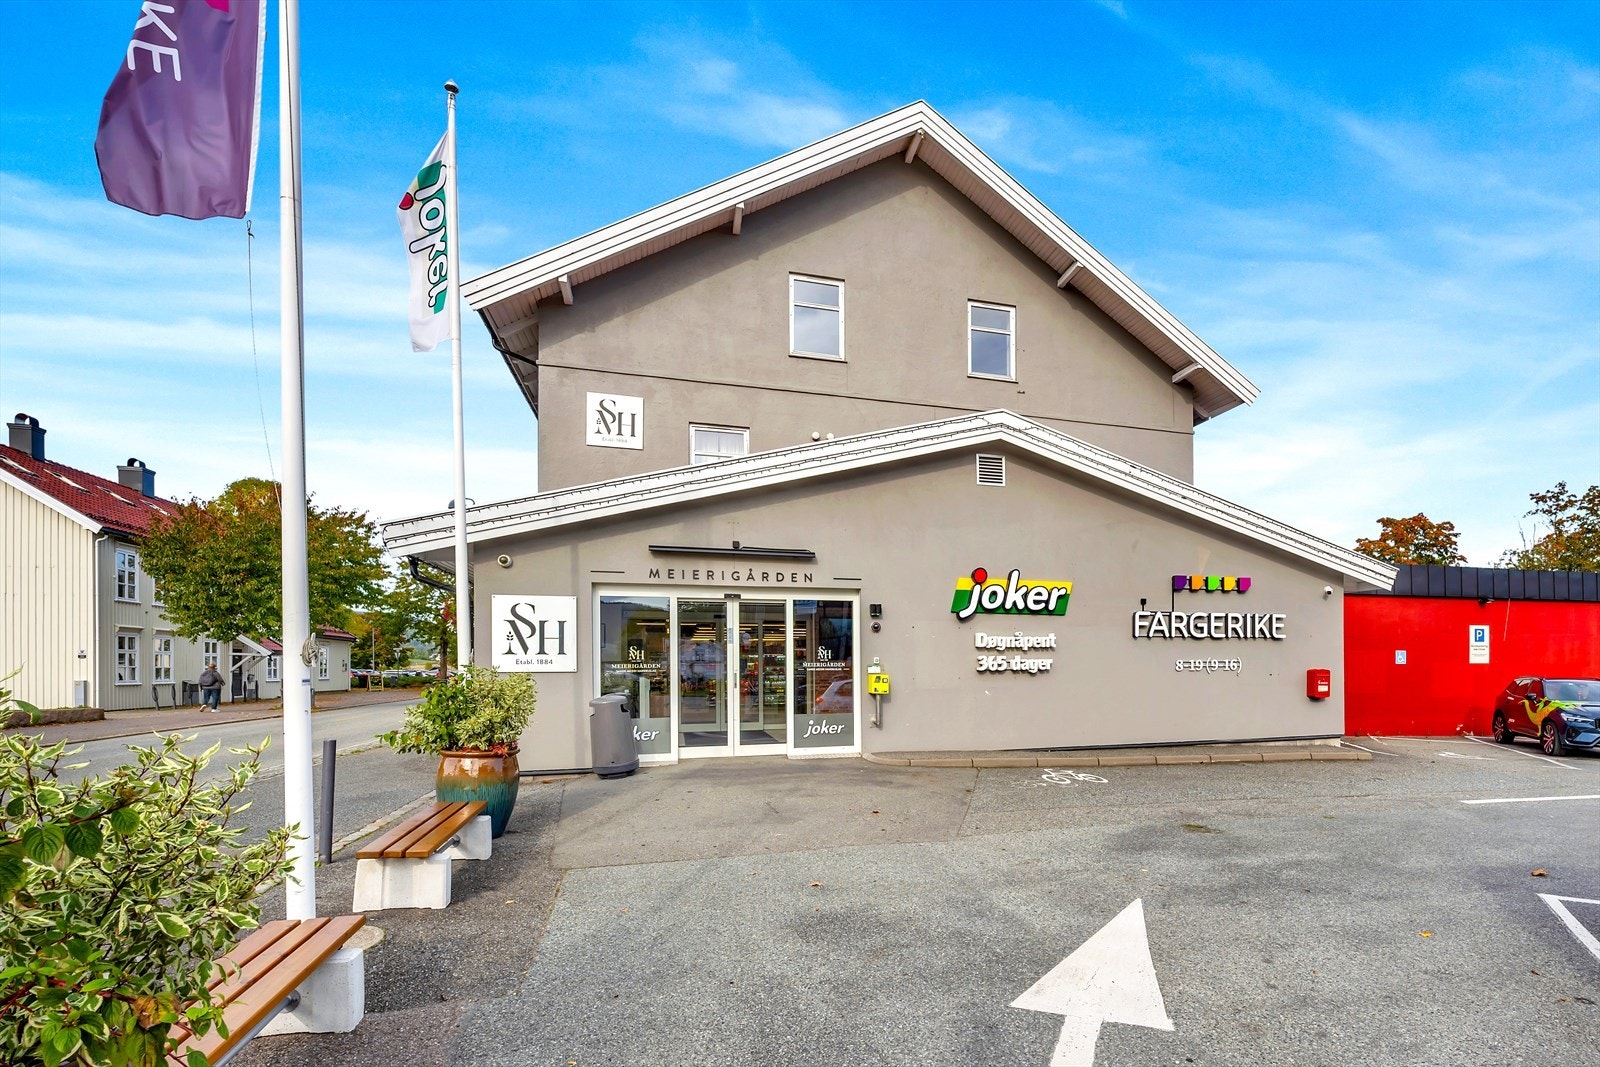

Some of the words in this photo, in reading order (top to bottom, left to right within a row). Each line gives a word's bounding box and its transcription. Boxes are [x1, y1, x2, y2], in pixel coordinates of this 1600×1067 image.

[648, 568, 813, 583] MEIERIGÅRDEN
[957, 567, 1067, 619] joker
[1133, 611, 1287, 640] FARGERIKE
[974, 631, 1057, 651] Døgnåpent
[976, 655, 1008, 672] 365
[1010, 655, 1053, 674] dager
[633, 725, 660, 741] ker
[803, 719, 845, 739] joker
